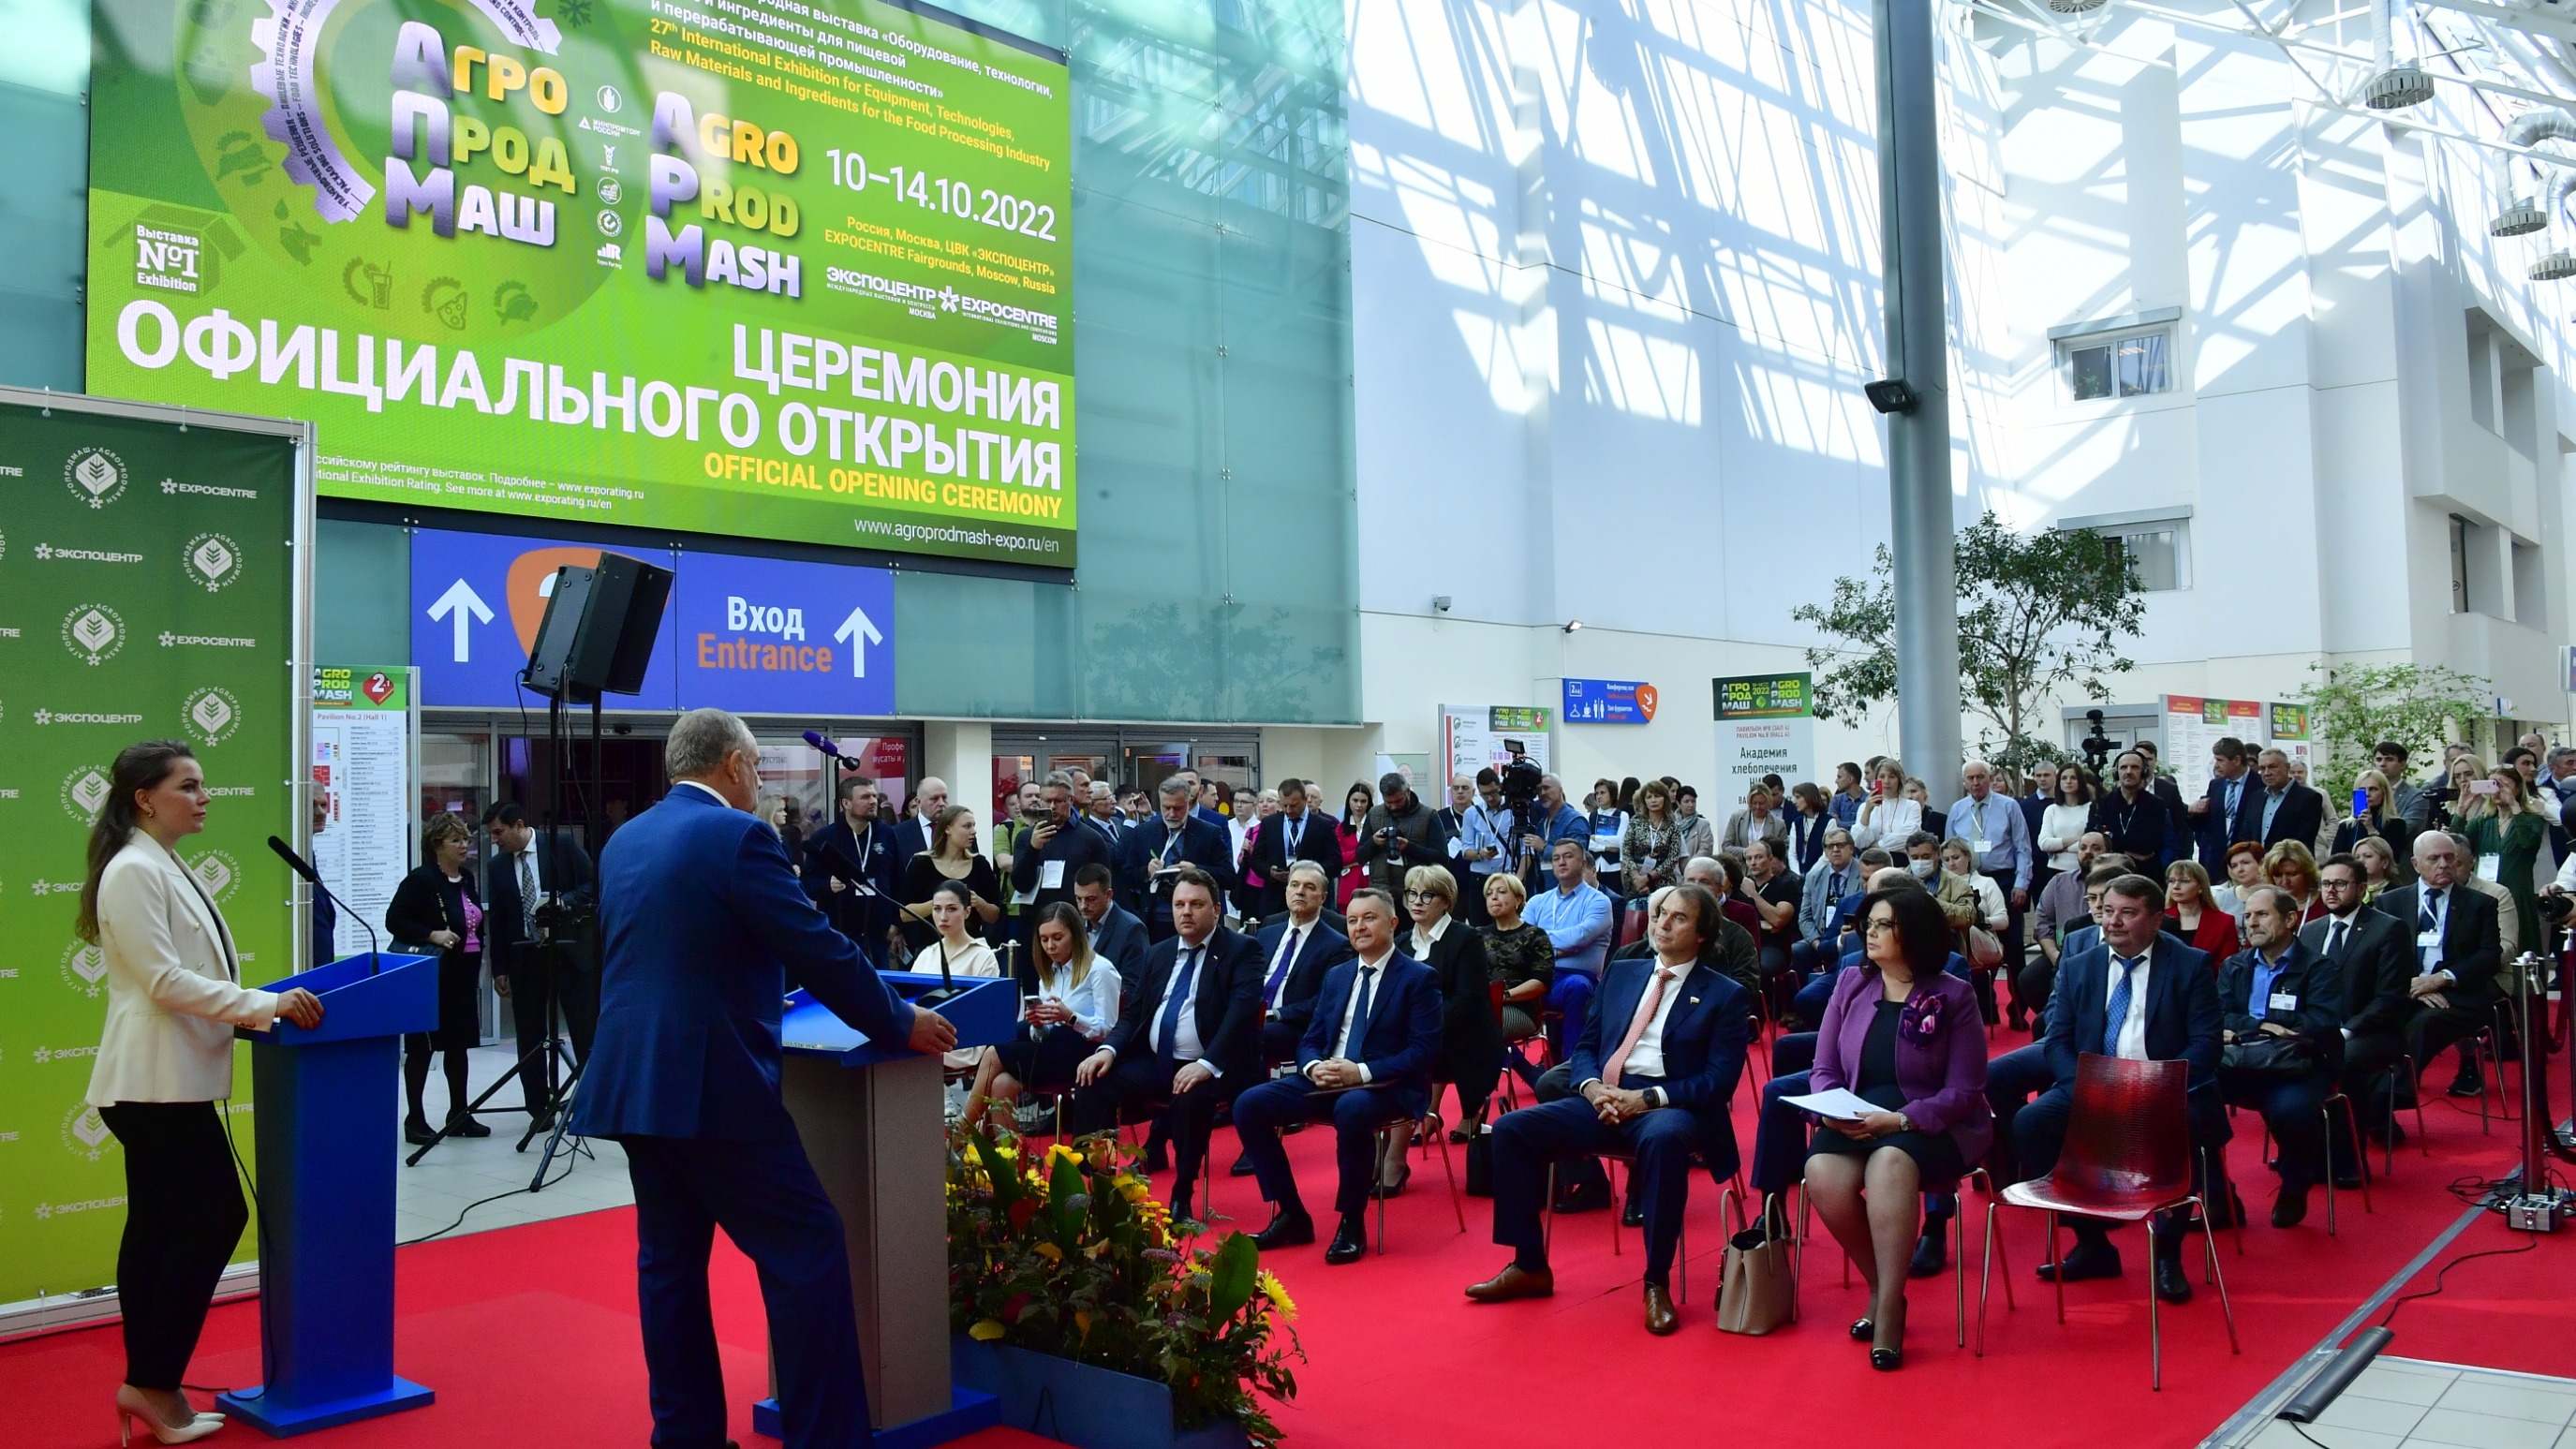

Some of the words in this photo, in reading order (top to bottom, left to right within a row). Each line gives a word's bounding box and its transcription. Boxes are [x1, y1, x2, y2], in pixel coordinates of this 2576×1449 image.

[499, 7, 526, 37] CONTROL
[718, 0, 813, 38] ингредиенты
[818, 32, 842, 48] для
[847, 40, 906, 68] пищевой
[390, 21, 569, 116] АГРО
[651, 1, 660, 11] и
[664, 4, 816, 60] перерабатывающей
[819, 52, 943, 98] промышленности»
[813, 8, 879, 39] выставка
[881, 31, 982, 75] «Оборудование,
[985, 65, 1053, 99] технологии,
[650, 18, 678, 36] 27th
[681, 26, 771, 67] International
[775, 55, 839, 87] Exhibition
[843, 76, 861, 94] for
[864, 82, 933, 118] Equipment,
[936, 105, 1014, 141] Technologies,
[650, 39, 682, 62] Raw
[686, 50, 753, 82] Materials
[756, 72, 782, 91] and
[785, 80, 859, 114] Ingredients
[862, 101, 881, 120] for
[882, 110, 903, 126] the
[906, 114, 937, 137] Food
[939, 125, 1003, 158] Processing
[1006, 145, 1051, 172] Industry
[391, 90, 576, 195] ПРОД
[650, 91, 799, 175] AGRO
[384, 156, 556, 247] МАШ
[650, 153, 799, 238] PROD
[825, 148, 1059, 243] 10–14.10.2022
[136, 224, 199, 246] Выставка
[645, 215, 802, 299] MASH
[847, 216, 894, 241] Россия,
[896, 228, 943, 253] Москва,
[945, 240, 970, 257] ЦВК
[971, 247, 1055, 277] «ЭКСПОЦЕНТР»
[137, 272, 197, 292] Exhibition
[824, 229, 905, 259] EXPOCENTRE
[907, 250, 974, 277] Fairgrounds,
[976, 264, 1021, 288] Moscow,
[1023, 278, 1056, 295] Russia
[826, 266, 937, 302] ЭКСПОЦЕНТР
[909, 307, 936, 319] МОСКВА
[961, 296, 1058, 330] EXPOCENTRE
[961, 312, 994, 322] INTERNATIONAL
[1031, 333, 1058, 345] MOSCOW
[116, 298, 761, 450] ОФИЦИАЛЬНОГО
[777, 401, 1061, 491] ОТКРЫТИЯ
[733, 323, 1060, 431] ЦЕРЕМОНИЯ
[64, 446, 91, 502] АГРОПРОДМАШ
[98, 447, 128, 504] AGROPRODMASH
[179, 483, 258, 498] EXPOCENTRE
[351, 472, 404, 487] Exhibition
[407, 478, 443, 495] Rating.
[445, 481, 466, 494] See
[467, 485, 494, 496] more
[496, 487, 506, 497] at
[508, 489, 613, 510] www.exporating.ru/en
[379, 462, 430, 478] рейтингу
[432, 468, 487, 482] выставок.
[490, 473, 547, 490] Подробнее
[557, 482, 644, 500] www.exporating.ru
[703, 451, 822, 491] OFFICIAL
[829, 468, 937, 504] OPENING
[941, 482, 1062, 520] CEREMONY
[55, 549, 143, 563] ЭКСПОЦЕНТР
[183, 532, 208, 585] АГРОПРОДМАШ
[853, 518, 1060, 554] www.agroprodmash-expo.ru/en
[215, 532, 243, 587] AGROPRODMASH
[61, 603, 88, 659] АГРОПРОДМАШ
[96, 603, 126, 660] AGROPRODMASH
[176, 636, 256, 647] EXPOCENTRE
[727, 596, 805, 642] Вход
[697, 632, 833, 673] Entrance
[1722, 683, 1751, 692] АГРО
[1722, 692, 1753, 701] ПРОД
[1722, 701, 1751, 710] МАШ
[1770, 680, 1800, 689] AGRO
[1770, 689, 1800, 699] PROD
[1770, 699, 1802, 708] MASH
[54, 713, 142, 724] ЭКСПОЦЕНТР
[181, 687, 206, 740] АГРОПРОДМАШ
[213, 687, 241, 741] AGROPRODMASH
[1731, 761, 1798, 775] хлебопечения
[1740, 747, 1787, 760] Академия
[54, 1046, 99, 1059] ЭКСПО
